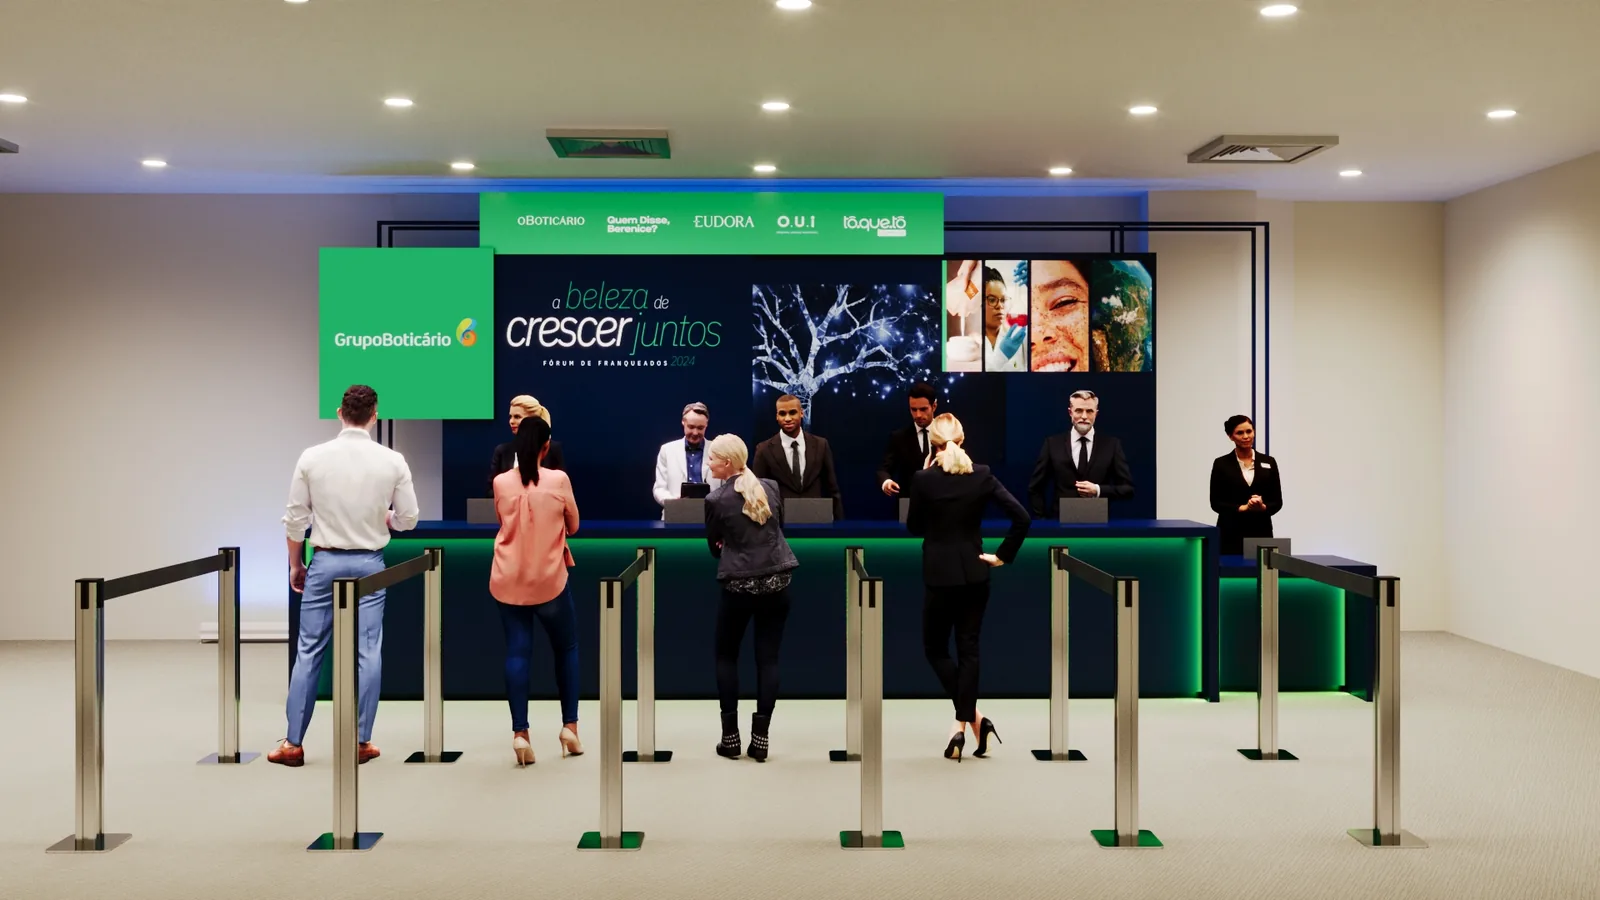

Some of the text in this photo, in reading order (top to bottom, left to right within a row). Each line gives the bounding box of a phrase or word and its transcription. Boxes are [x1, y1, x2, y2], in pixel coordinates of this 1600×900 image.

[607, 215, 670, 226] Quem Disse,
[693, 215, 755, 228] EUDORA
[607, 224, 658, 233] Berenice?
[552, 281, 670, 310] a beleza de
[506, 312, 722, 356] crescer juntos
[334, 332, 452, 350] GrupoBoticário
[543, 359, 575, 367] FÓRUM
[670, 355, 696, 367] 2024
